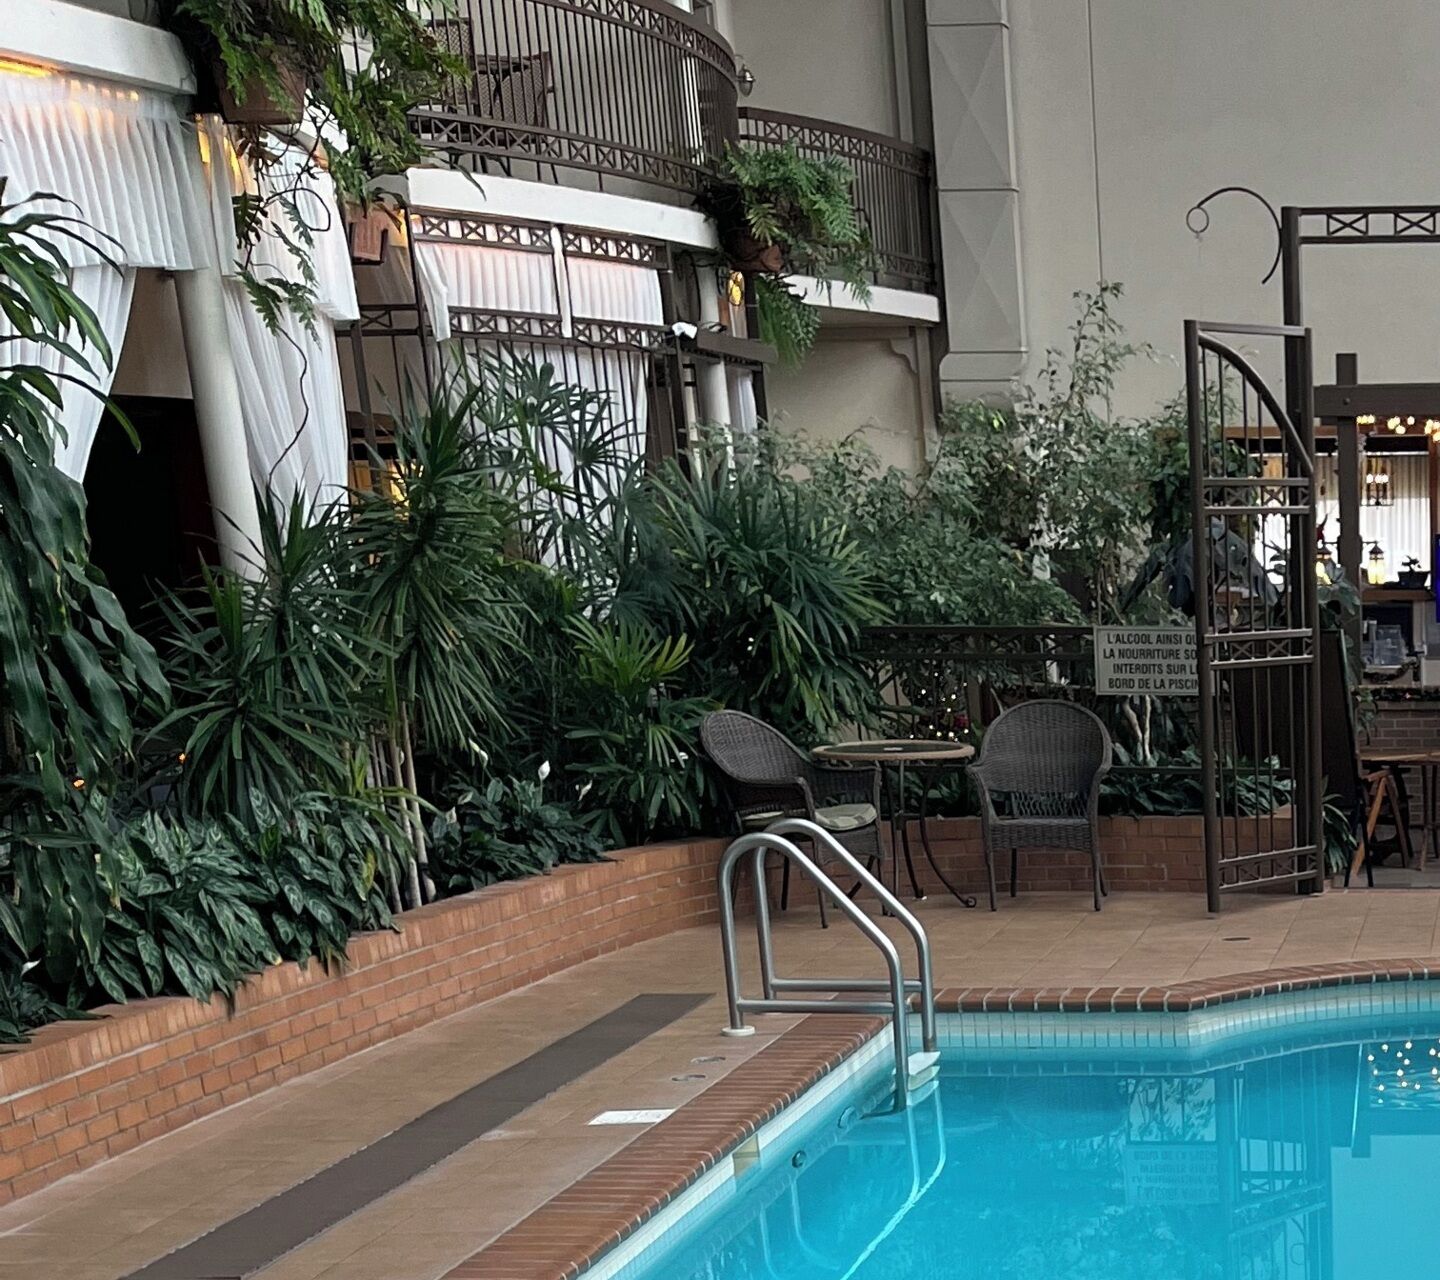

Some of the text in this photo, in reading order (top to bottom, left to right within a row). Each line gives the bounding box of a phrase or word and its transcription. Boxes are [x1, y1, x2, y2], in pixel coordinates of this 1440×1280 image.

[1107, 633, 1153, 645] L'ALCOOL
[1155, 633, 1182, 645] AINSI
[1103, 648, 1115, 660] LA
[1118, 648, 1181, 660] NOURRITURE
[1113, 663, 1163, 675] INTERDITS
[1166, 663, 1187, 675] SUR
[1108, 678, 1135, 690] BORD
[1138, 678, 1151, 690] DE
[1154, 678, 1166, 690] LA
